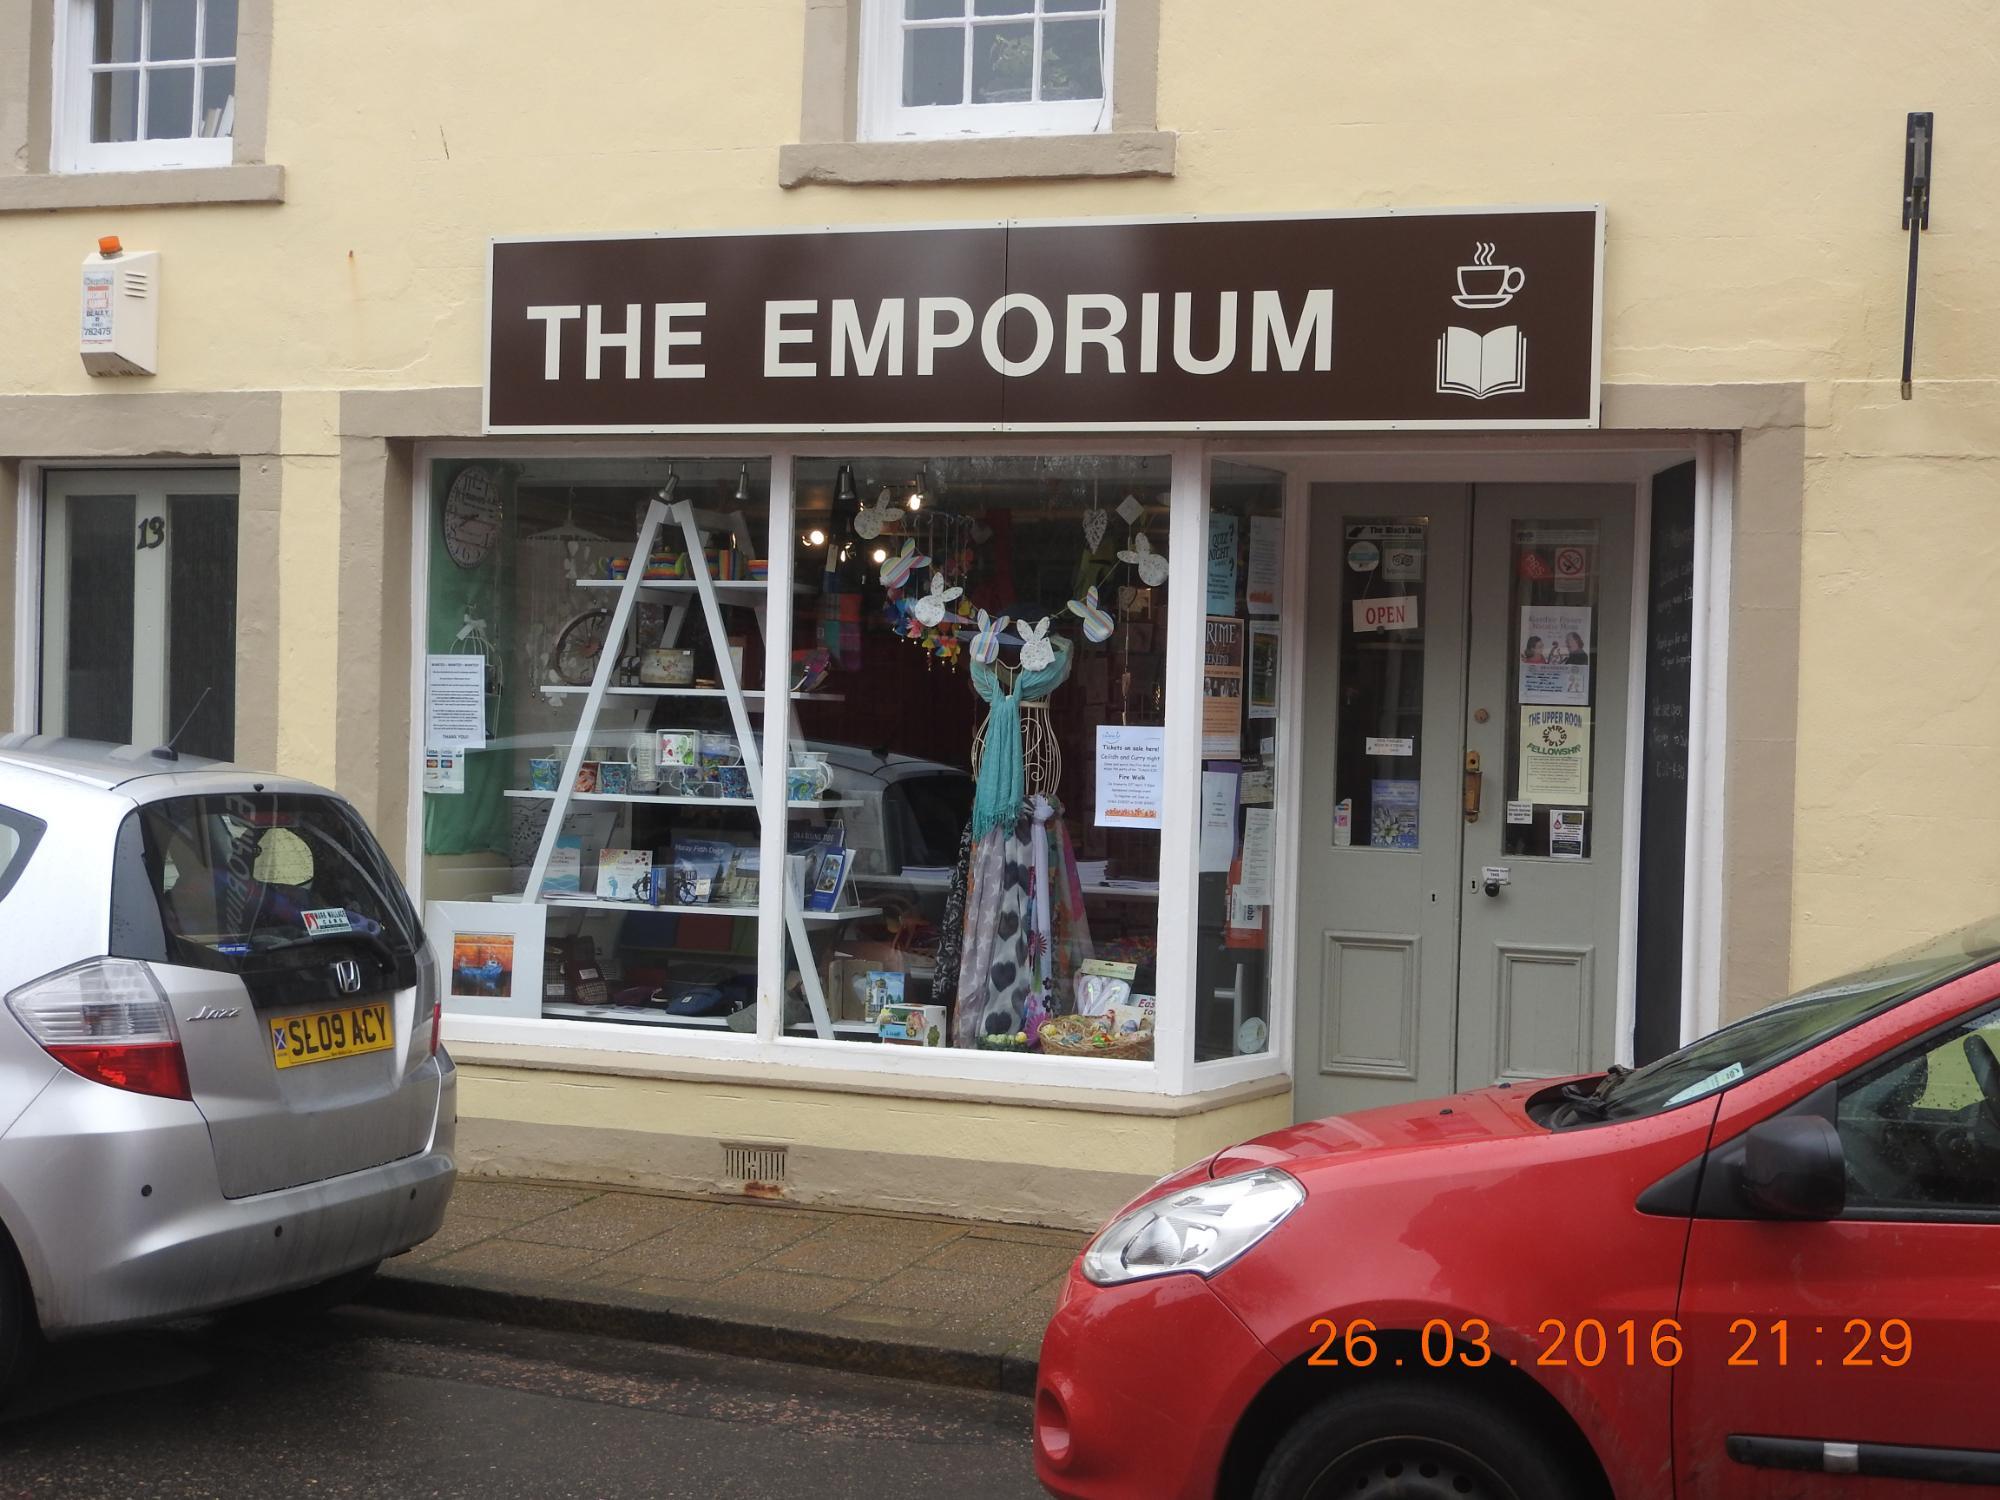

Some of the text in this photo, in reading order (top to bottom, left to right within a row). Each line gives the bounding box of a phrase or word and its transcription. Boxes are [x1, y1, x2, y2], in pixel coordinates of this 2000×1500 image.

[526, 289, 1334, 380] THE EMPORIUM
[137, 516, 165, 550] 13
[1366, 604, 1405, 625] OPEN
[1206, 622, 1237, 648] RIME
[1529, 713, 1541, 728] THE
[1542, 711, 1563, 725] UPPER
[1542, 724, 1568, 747] CHRISTIAN
[1527, 742, 1582, 756] FELLOWSHIP
[288, 1006, 386, 1056] SL09 ACY
